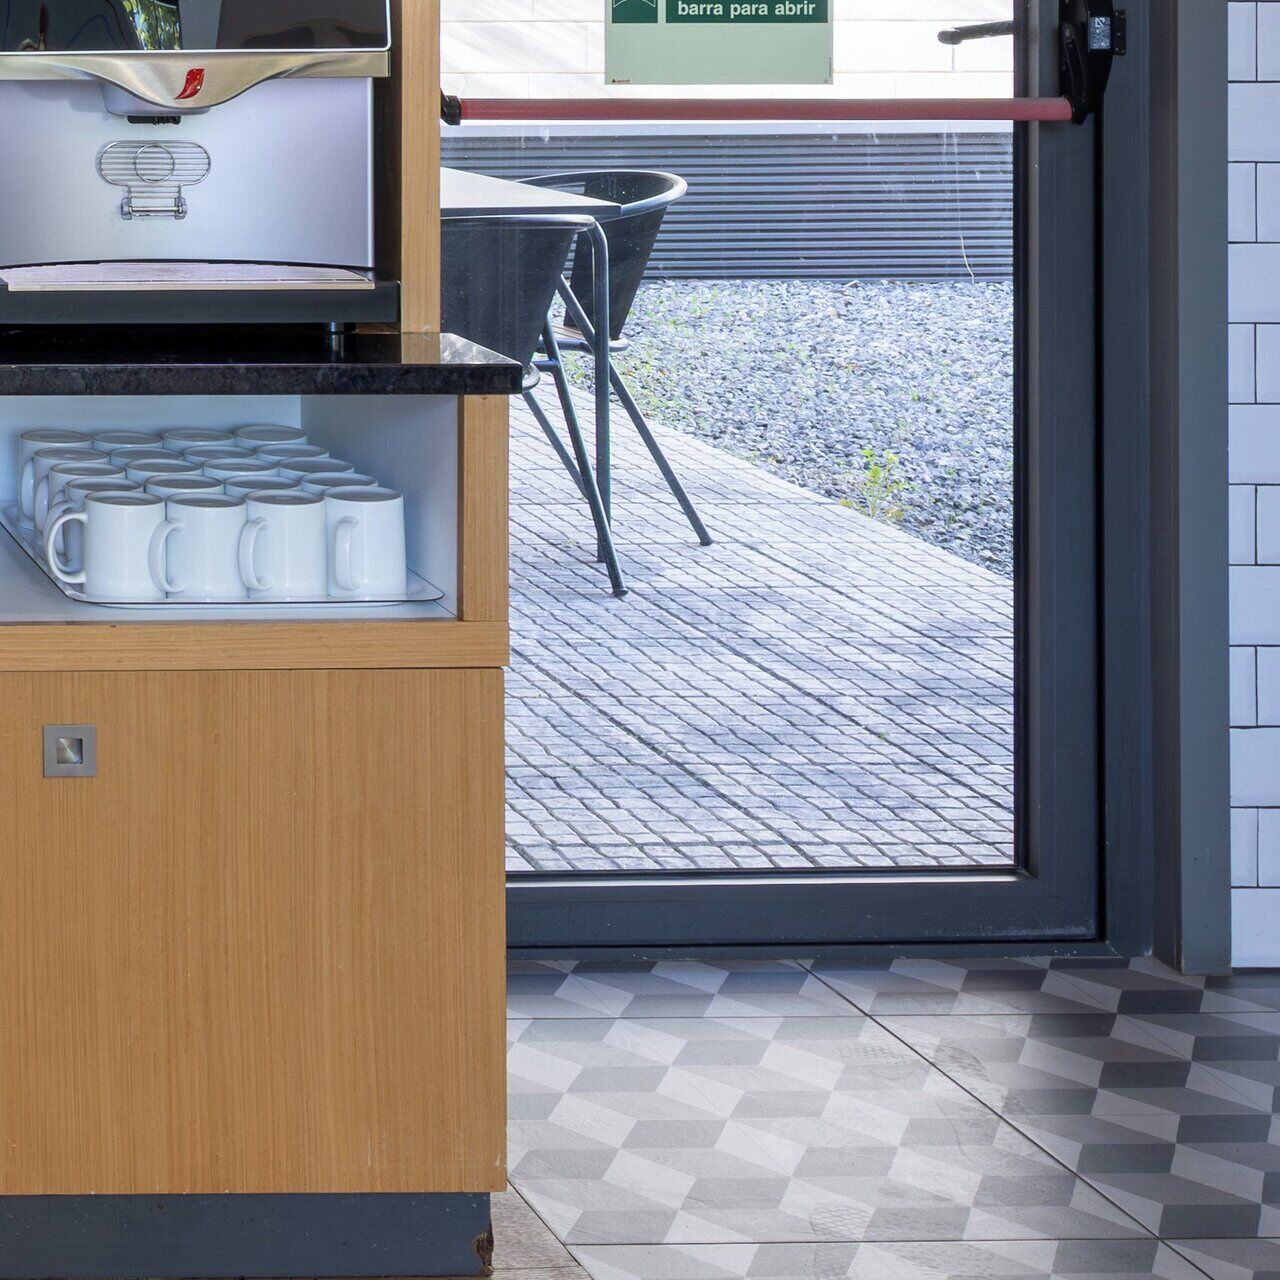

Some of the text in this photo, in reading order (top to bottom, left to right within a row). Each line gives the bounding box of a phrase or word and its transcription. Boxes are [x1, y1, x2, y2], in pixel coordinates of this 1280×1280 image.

[678, 1, 815, 18] barra para abrir
